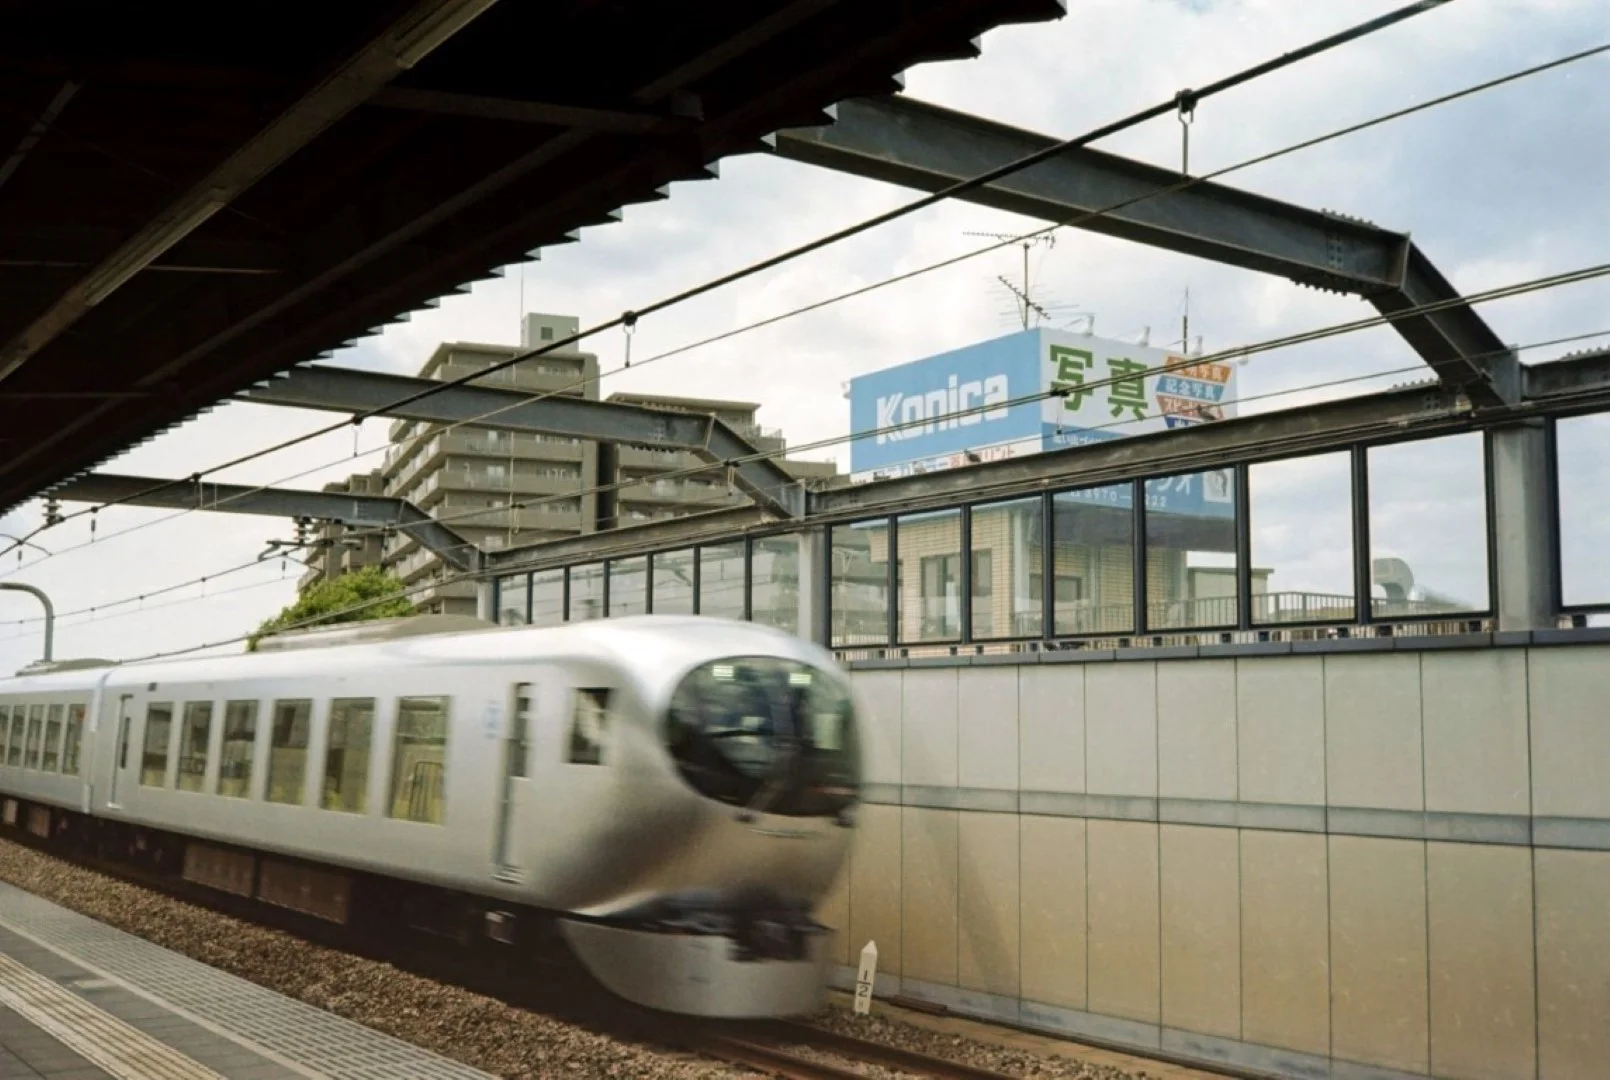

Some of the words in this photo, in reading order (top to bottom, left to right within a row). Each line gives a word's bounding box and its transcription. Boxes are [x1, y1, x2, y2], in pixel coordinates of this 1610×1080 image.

[876, 374, 1009, 445] Konica
[1050, 344, 1148, 421] 写真
[1165, 378, 1215, 400] 記念写真
